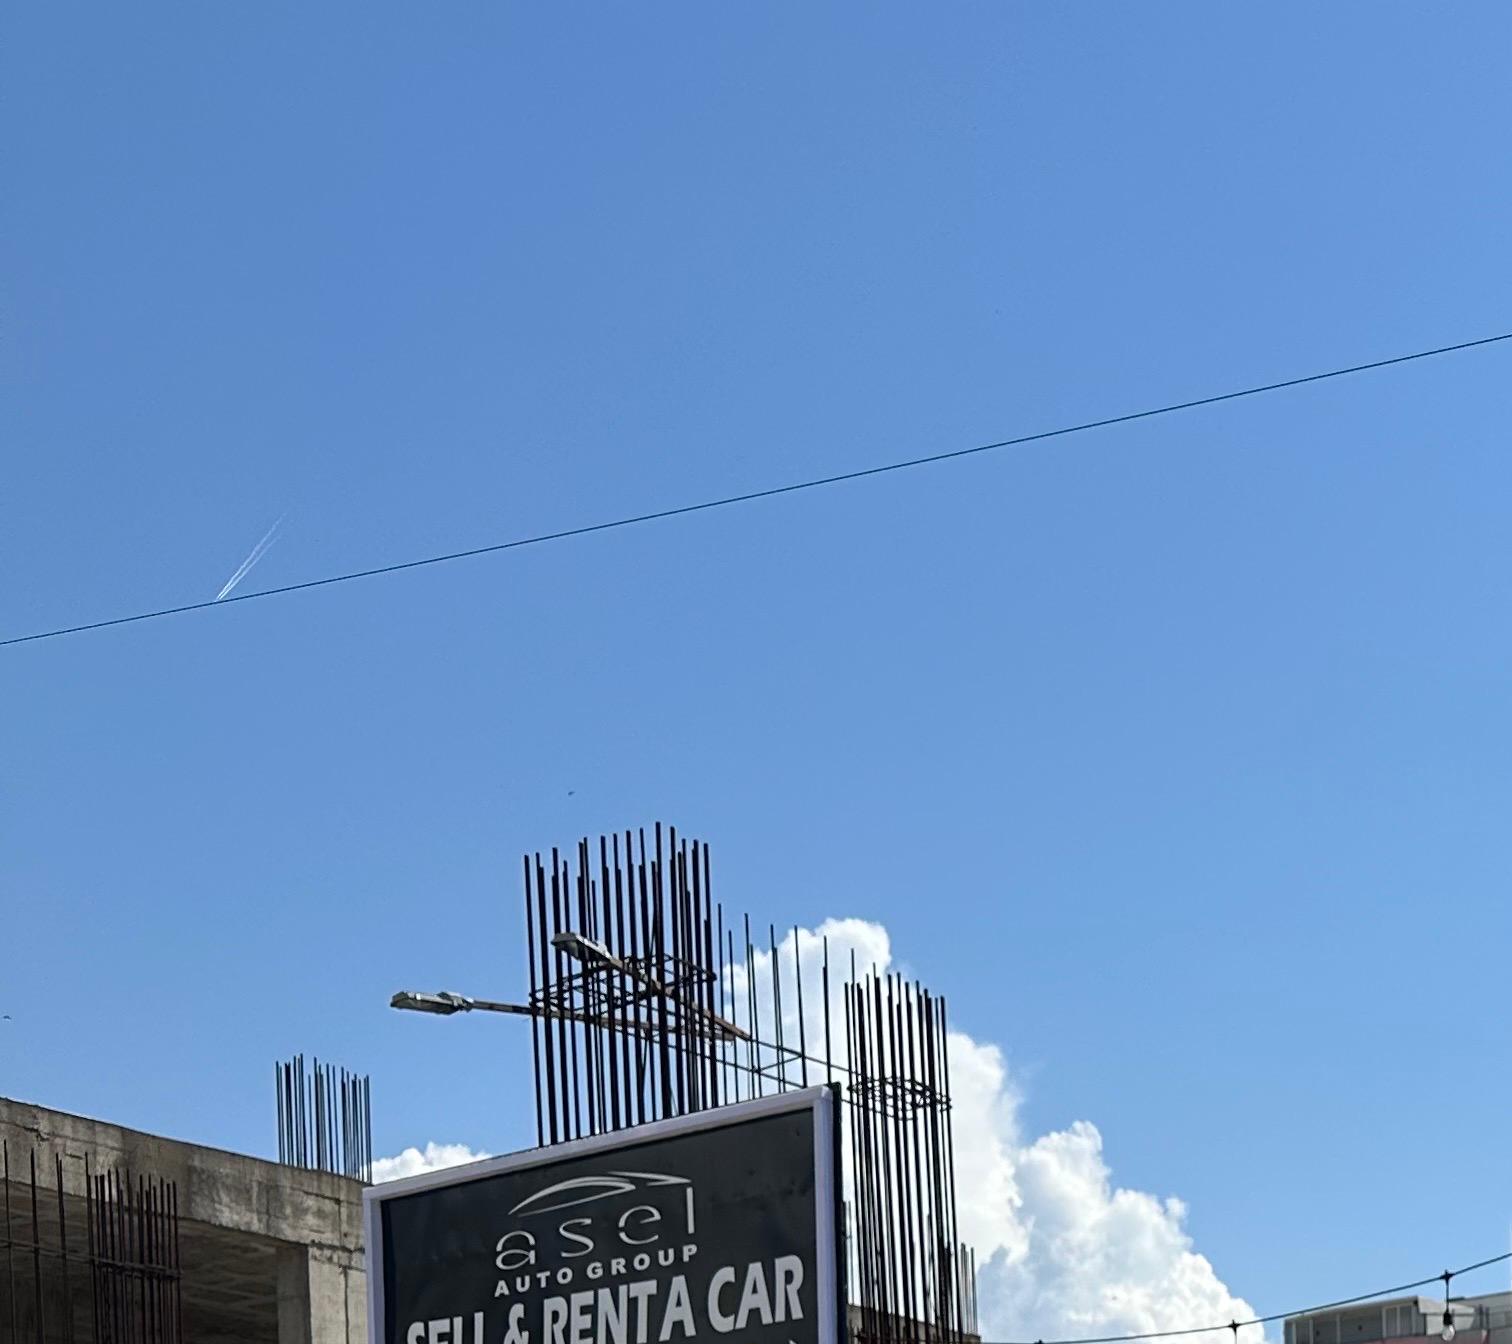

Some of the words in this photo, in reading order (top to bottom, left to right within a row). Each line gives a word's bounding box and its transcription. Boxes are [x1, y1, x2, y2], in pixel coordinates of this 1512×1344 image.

[495, 1187, 695, 1270] asel
[494, 1267, 573, 1298] AUTO
[586, 1244, 698, 1279] GROUP
[658, 1275, 697, 1342] A
[708, 1254, 804, 1333] CAR
